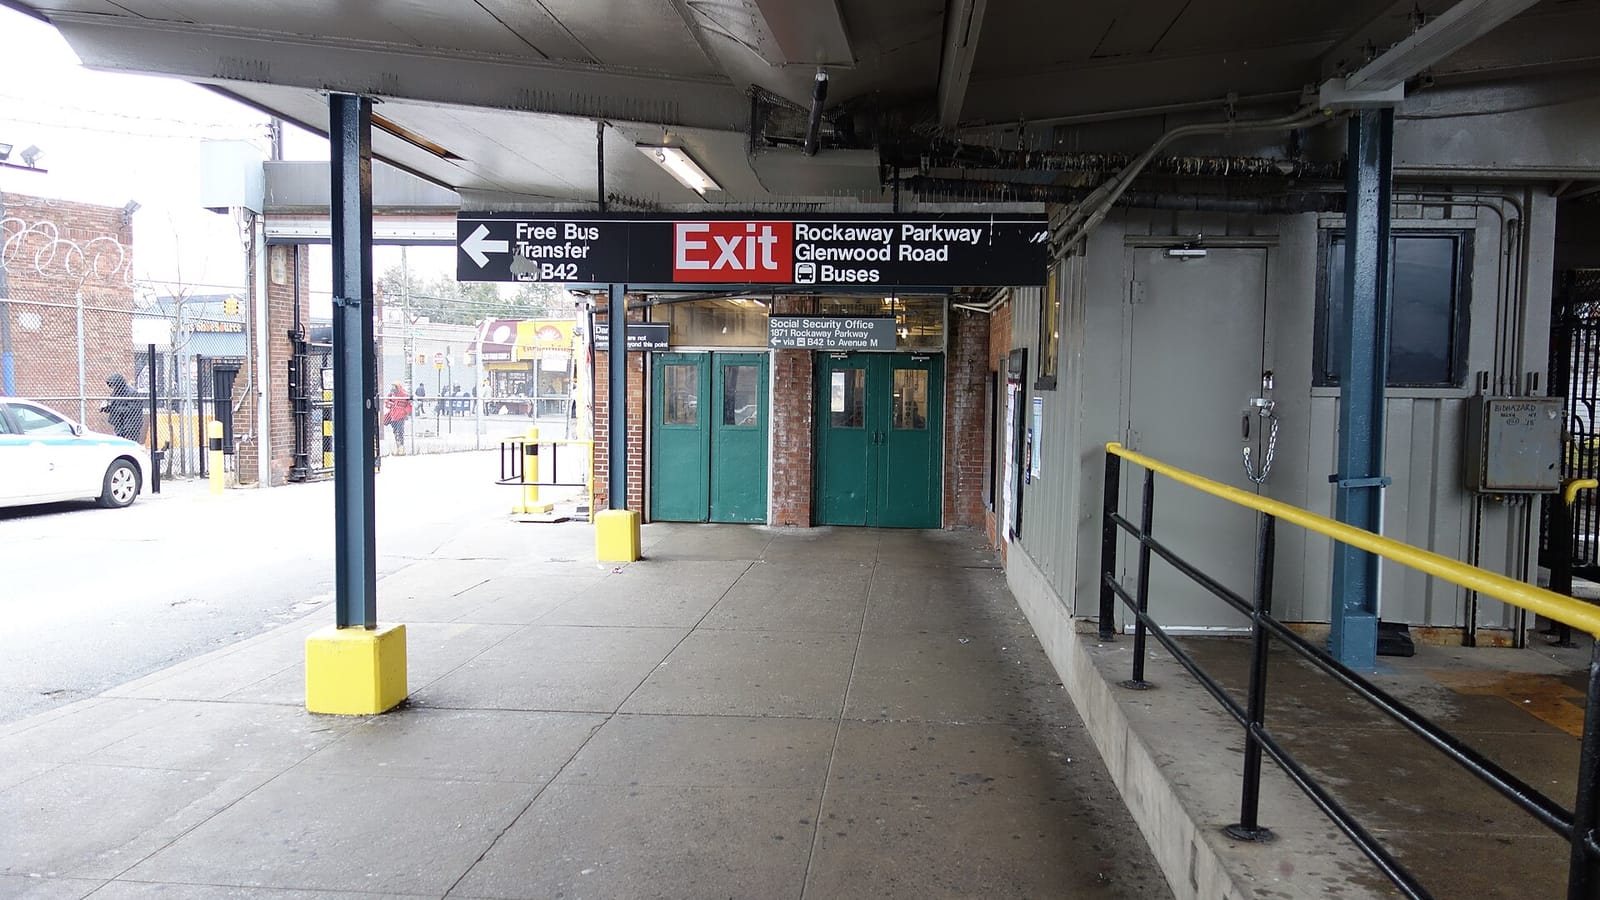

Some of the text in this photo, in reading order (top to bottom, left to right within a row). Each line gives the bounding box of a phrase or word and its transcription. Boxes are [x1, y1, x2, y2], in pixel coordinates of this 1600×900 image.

[515, 222, 600, 240] Free Bus
[795, 223, 982, 245] Rockaway Parkway
[515, 241, 590, 259] Transfer
[675, 223, 778, 271] Exit
[795, 243, 949, 262] Glenwood Road
[541, 263, 579, 281] B42
[820, 264, 881, 283] Buses
[770, 319, 874, 330] Social Security Office
[770, 329, 869, 339] 1871 Rockaway Parkway
[783, 338, 878, 347] via B42 to Avenue M
[654, 341, 669, 349] point
